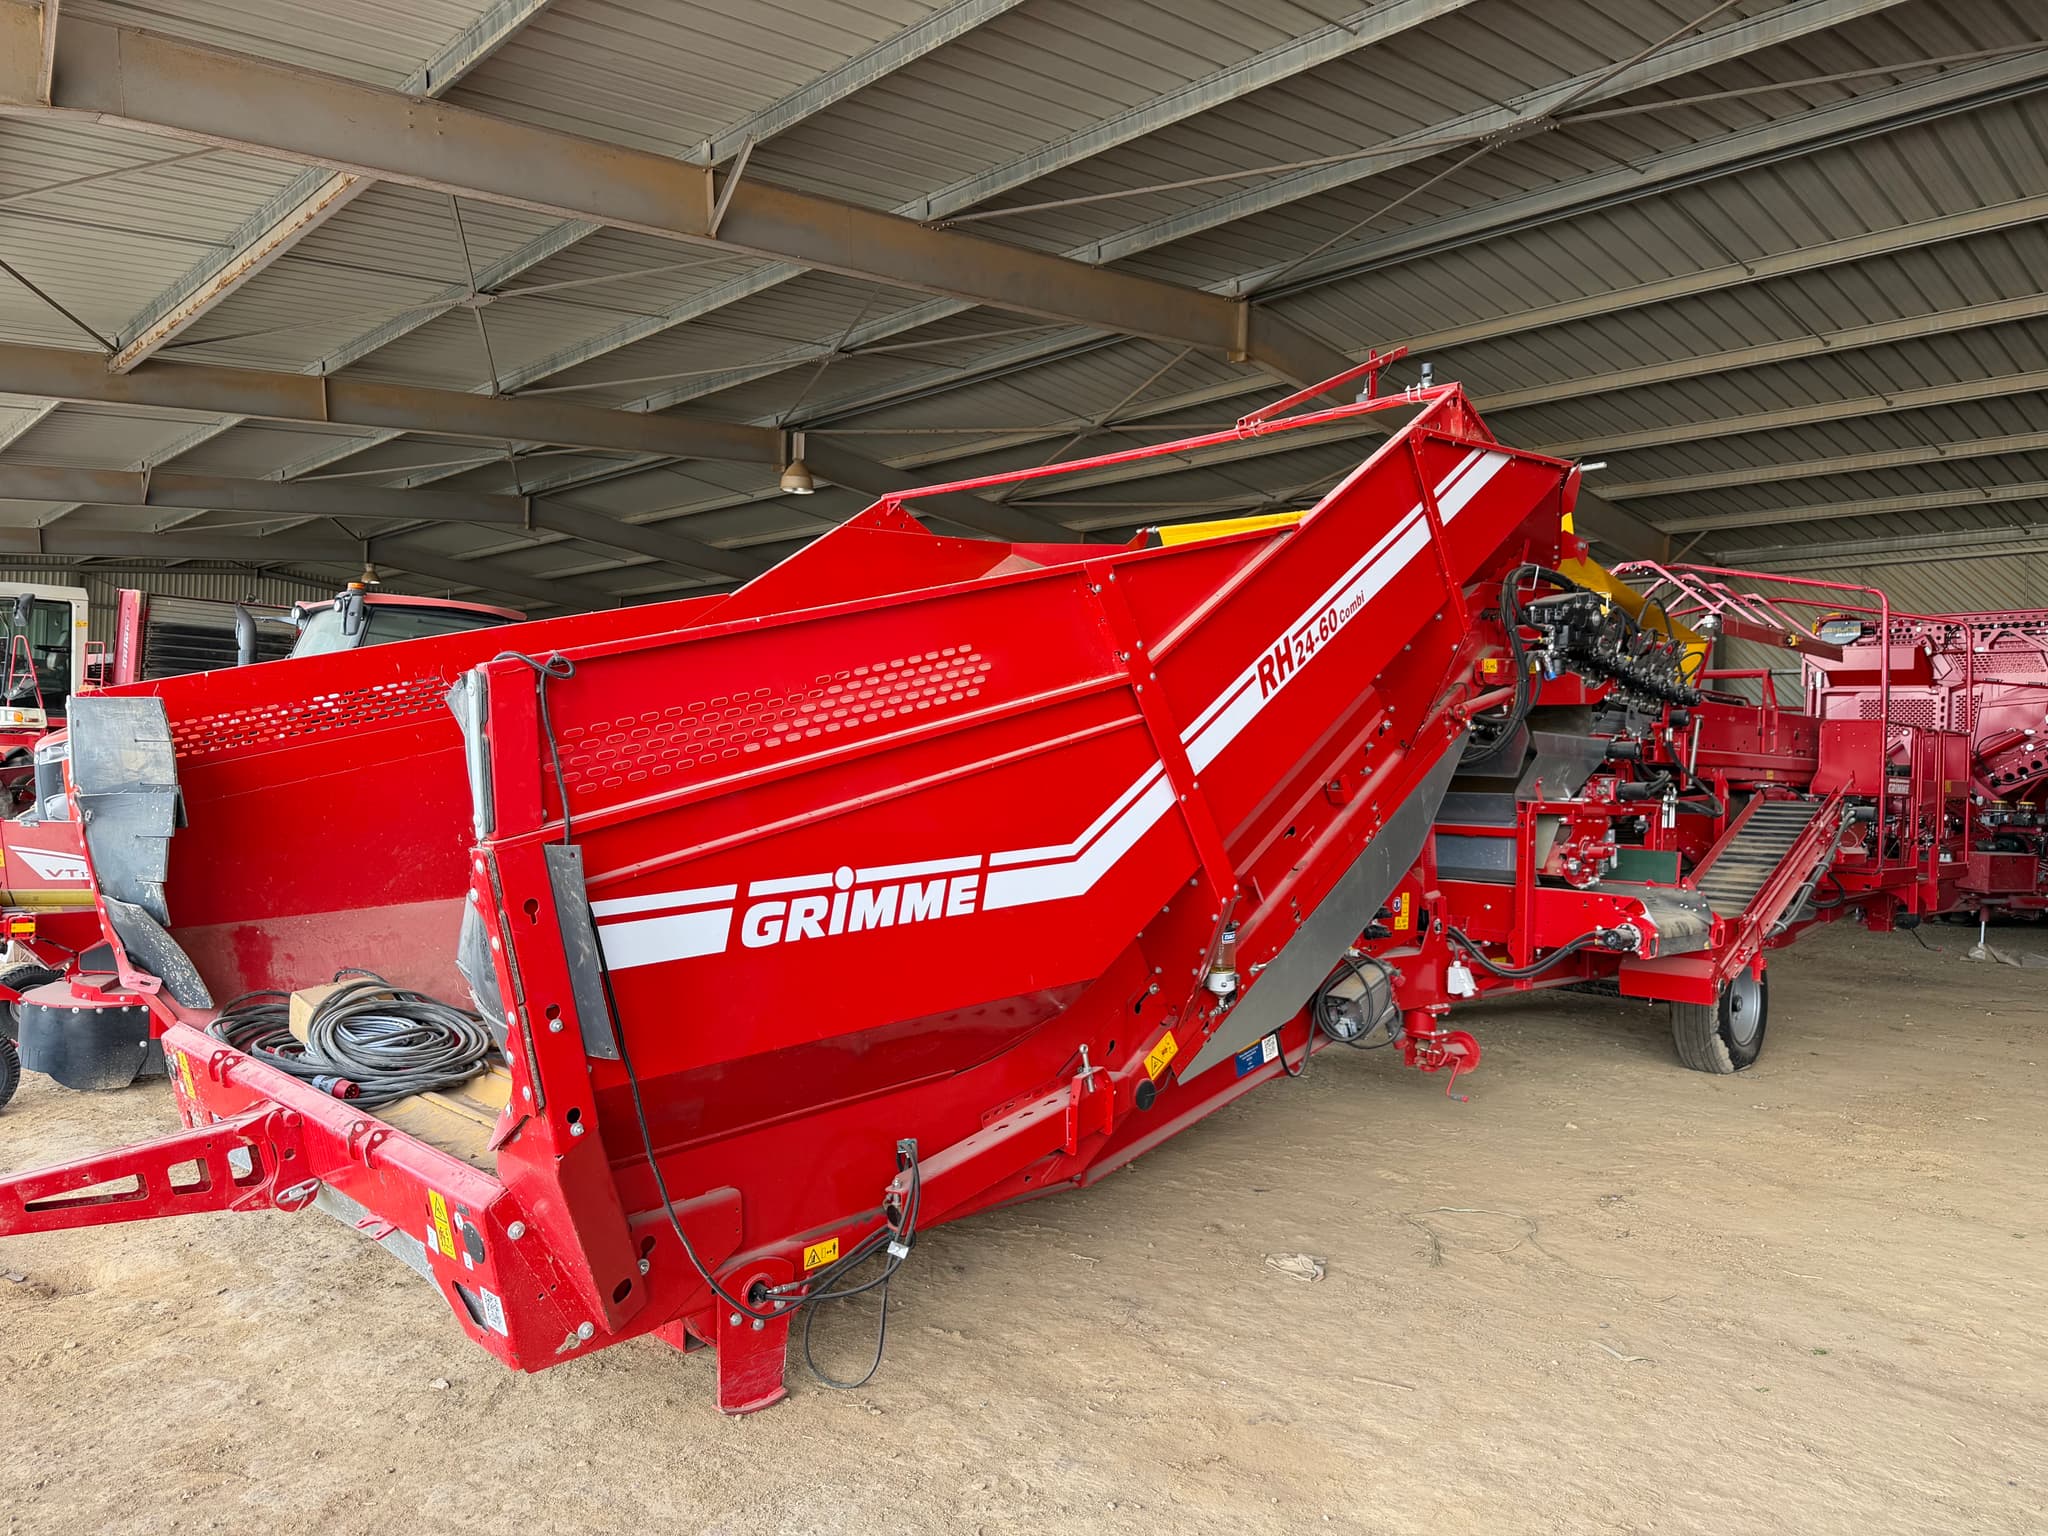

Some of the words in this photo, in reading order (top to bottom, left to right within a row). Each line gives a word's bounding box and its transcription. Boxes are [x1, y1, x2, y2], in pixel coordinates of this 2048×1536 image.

[1257, 635, 1294, 700] RH
[1295, 607, 1338, 668] 24-60
[741, 867, 980, 949] GRIMME
